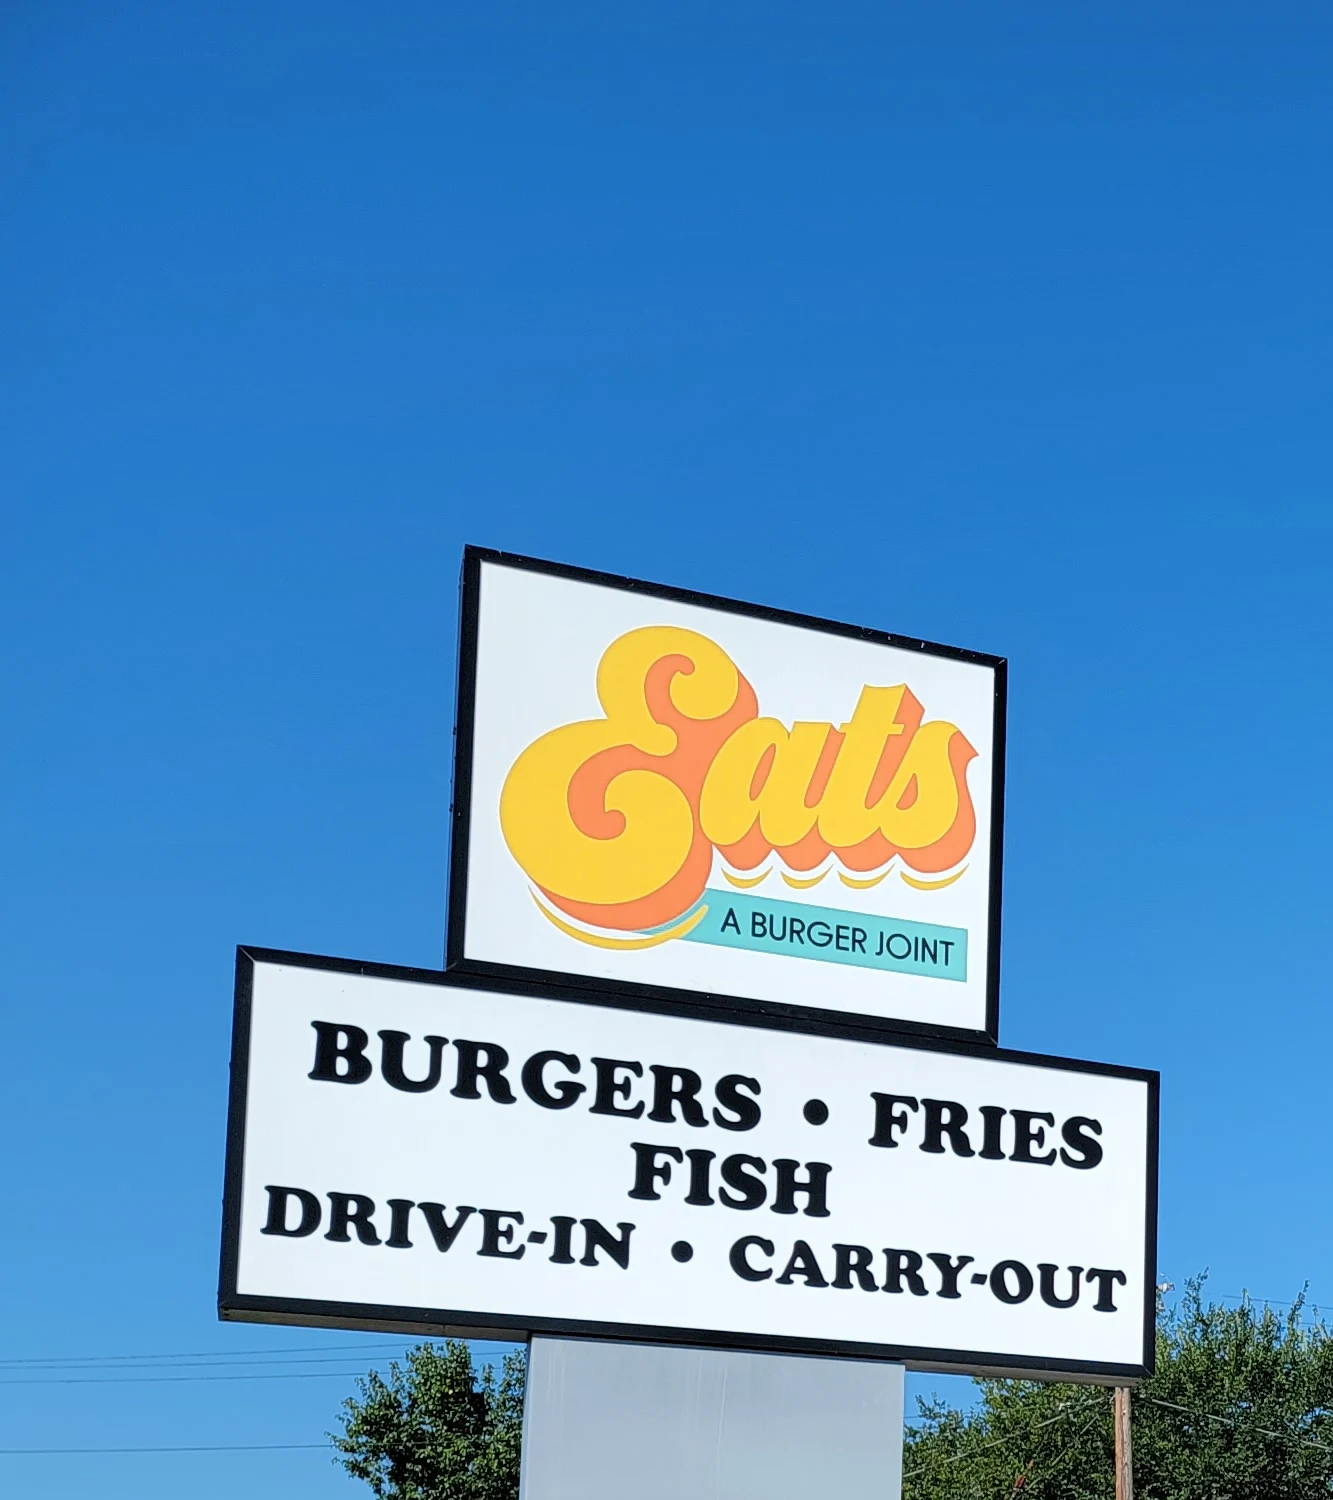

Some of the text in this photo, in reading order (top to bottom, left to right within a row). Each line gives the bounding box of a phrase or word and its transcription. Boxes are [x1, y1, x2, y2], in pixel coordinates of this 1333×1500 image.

[500, 625, 979, 931] Eats
[720, 907, 955, 967] A BURGER JOINT
[307, 1020, 1103, 1170] BURGERS FRIES
[627, 1142, 832, 1218] FISH
[260, 1185, 1127, 1313] DRIVE-IN CARRY-OUT
